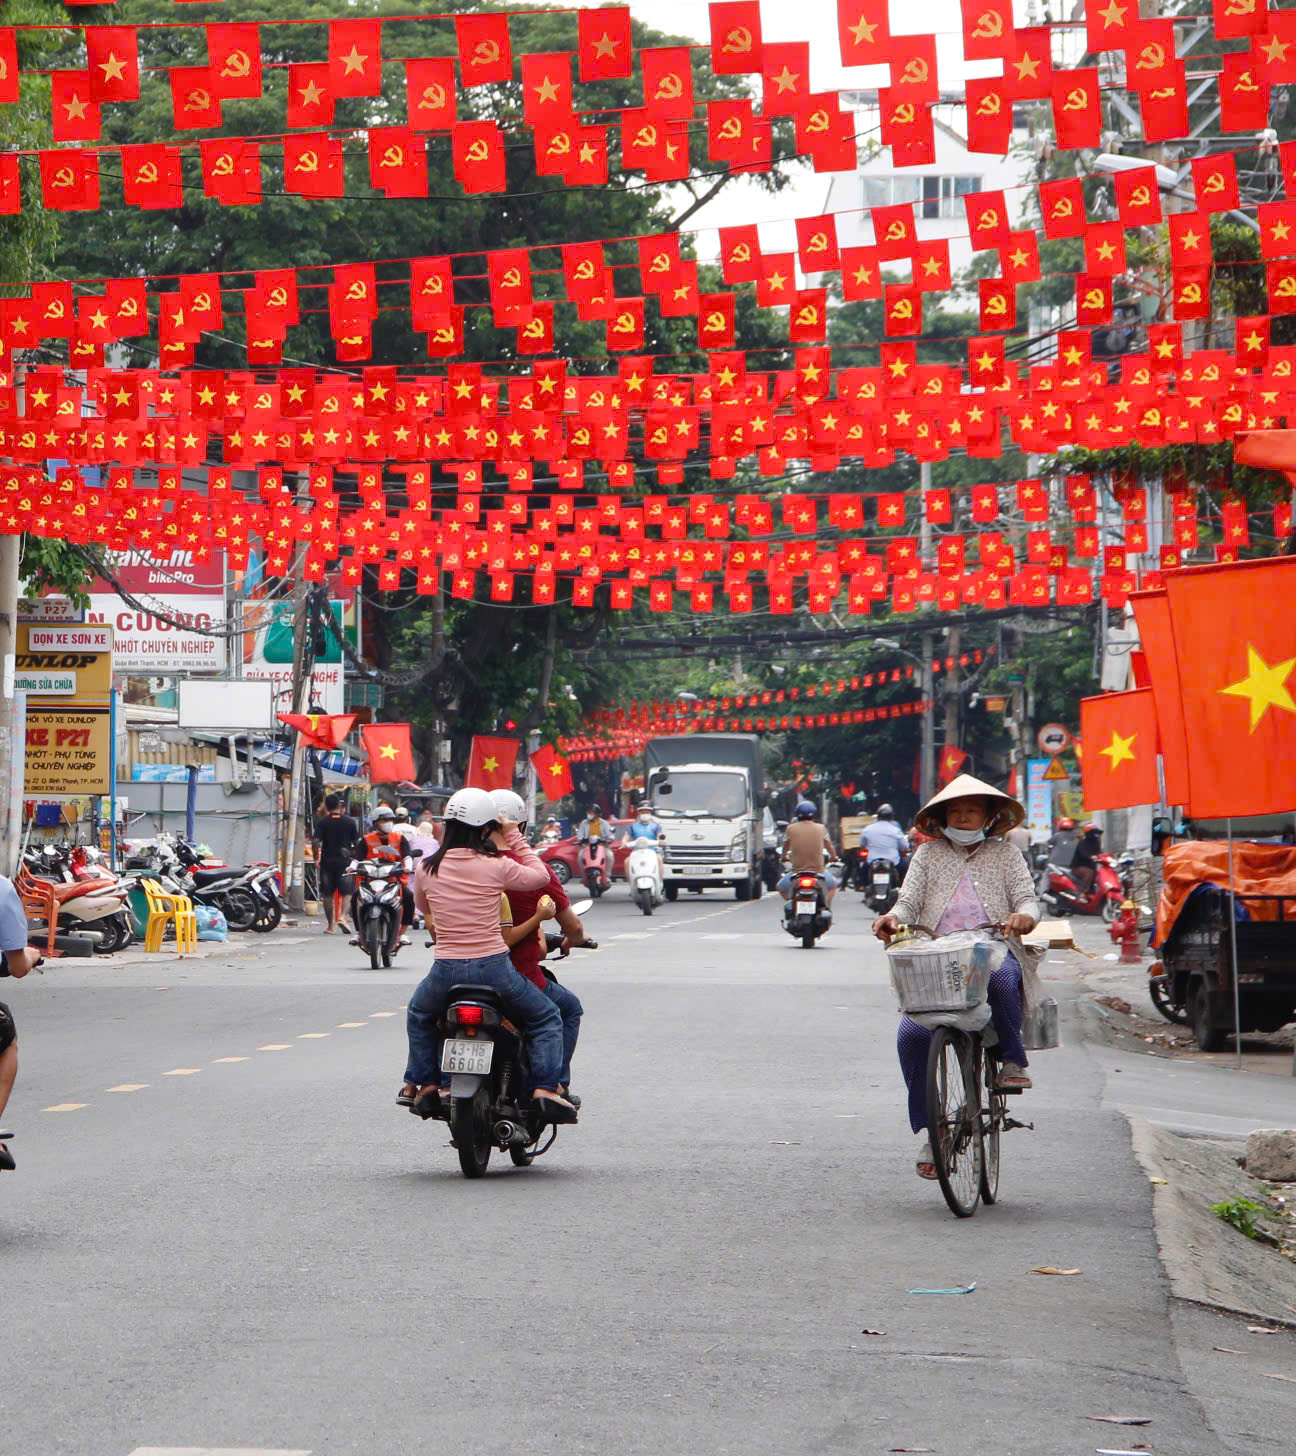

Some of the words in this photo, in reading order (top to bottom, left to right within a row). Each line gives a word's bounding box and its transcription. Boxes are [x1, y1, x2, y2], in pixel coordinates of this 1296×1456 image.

[148, 571, 195, 584] bikePro
[45, 605, 68, 615] P27
[56, 633, 68, 644] XE
[72, 632, 91, 645] SƠN
[94, 633, 106, 645] XE
[142, 637, 178, 654] CHUYÊN
[15, 654, 98, 668] UNLOP
[38, 675, 53, 690] SỬA
[26, 715, 39, 724] HỐI
[55, 716, 65, 724] XE
[67, 716, 97, 724] DUNLOP
[55, 728, 91, 747] P27
[54, 751, 71, 760] PHỤ
[75, 750, 96, 759] TÙNG
[32, 761, 64, 771] CHUYÊN
[67, 762, 95, 772] NGHIỆP
[950, 960, 961, 992] SAIGON
[448, 1057, 484, 1072] 6606
